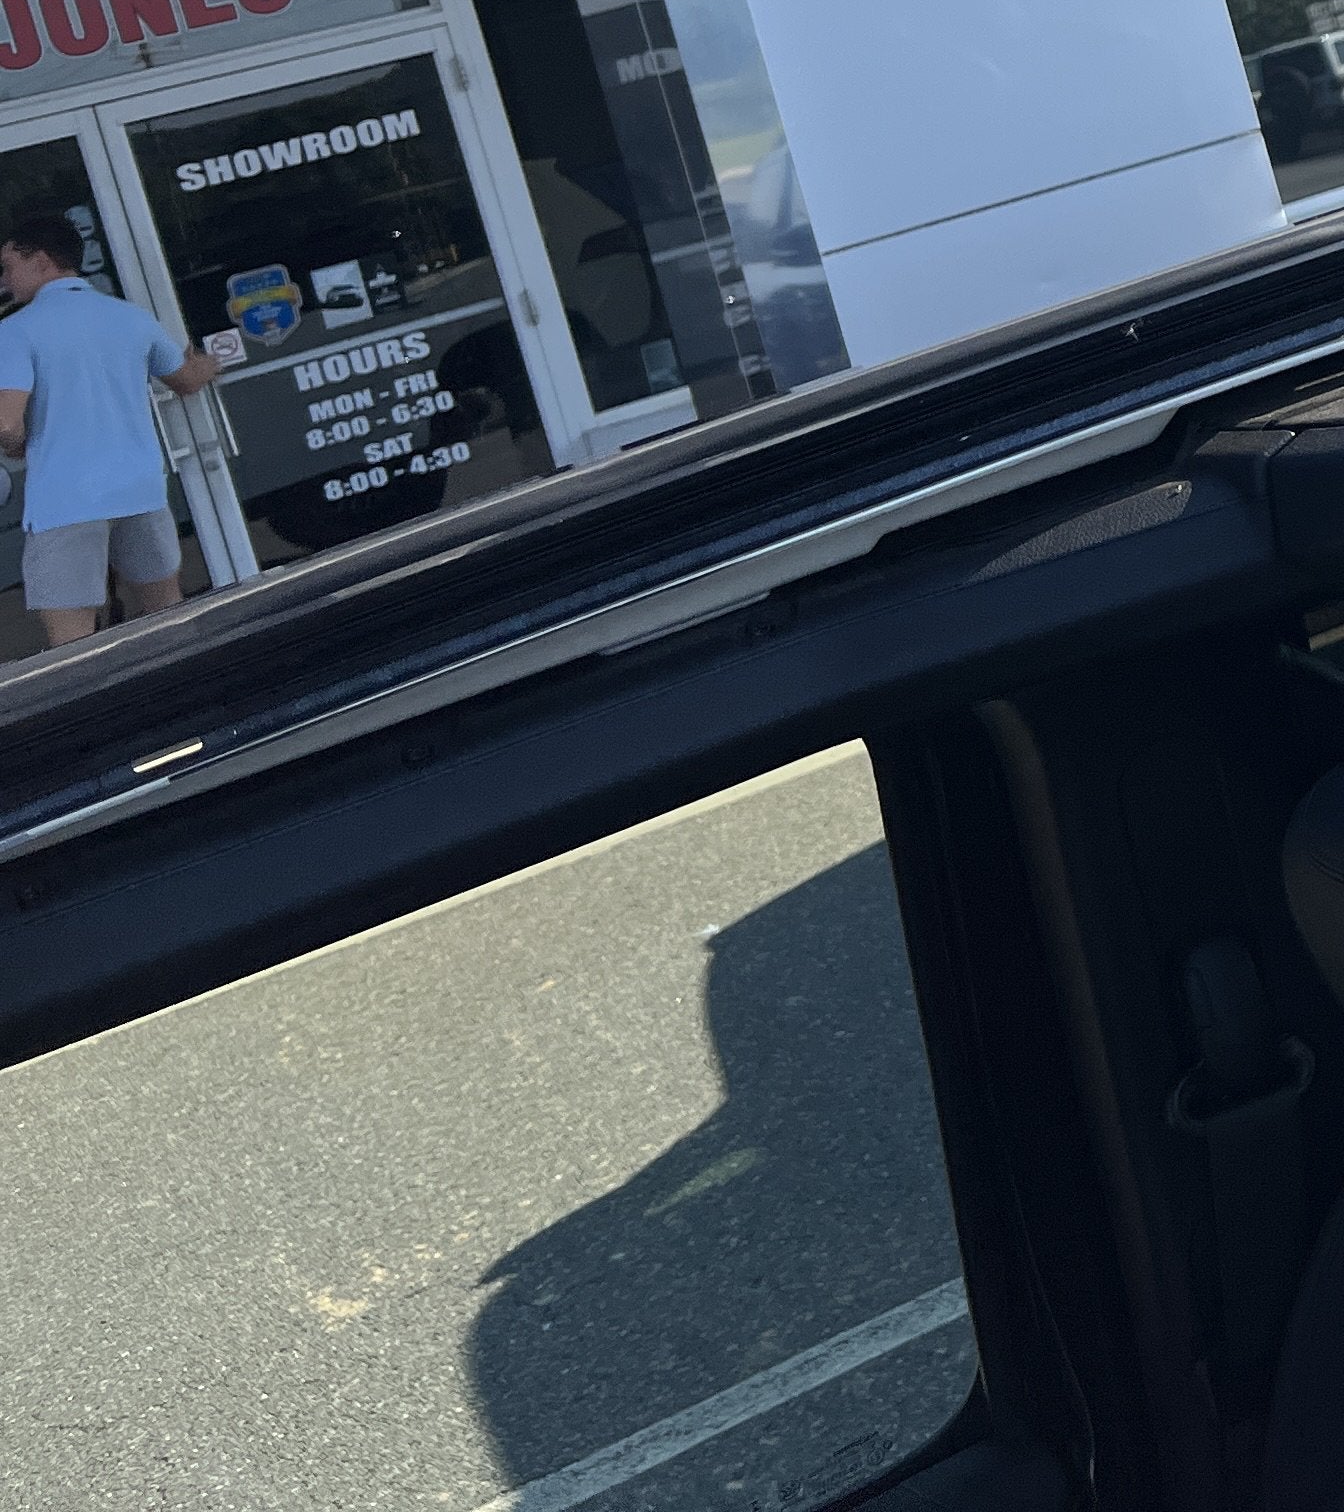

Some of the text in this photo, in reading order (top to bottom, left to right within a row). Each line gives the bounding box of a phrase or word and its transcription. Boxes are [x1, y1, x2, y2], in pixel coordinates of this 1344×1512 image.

[175, 109, 421, 193] SHOWROOM
[293, 331, 431, 393] HOURS
[305, 415, 370, 451] 8:00
[391, 390, 456, 426] 6:30
[307, 387, 374, 424] MON
[393, 369, 440, 398] FRI
[322, 466, 389, 502] 8:00
[409, 441, 471, 476] 4:30
[363, 433, 414, 464] SAT
